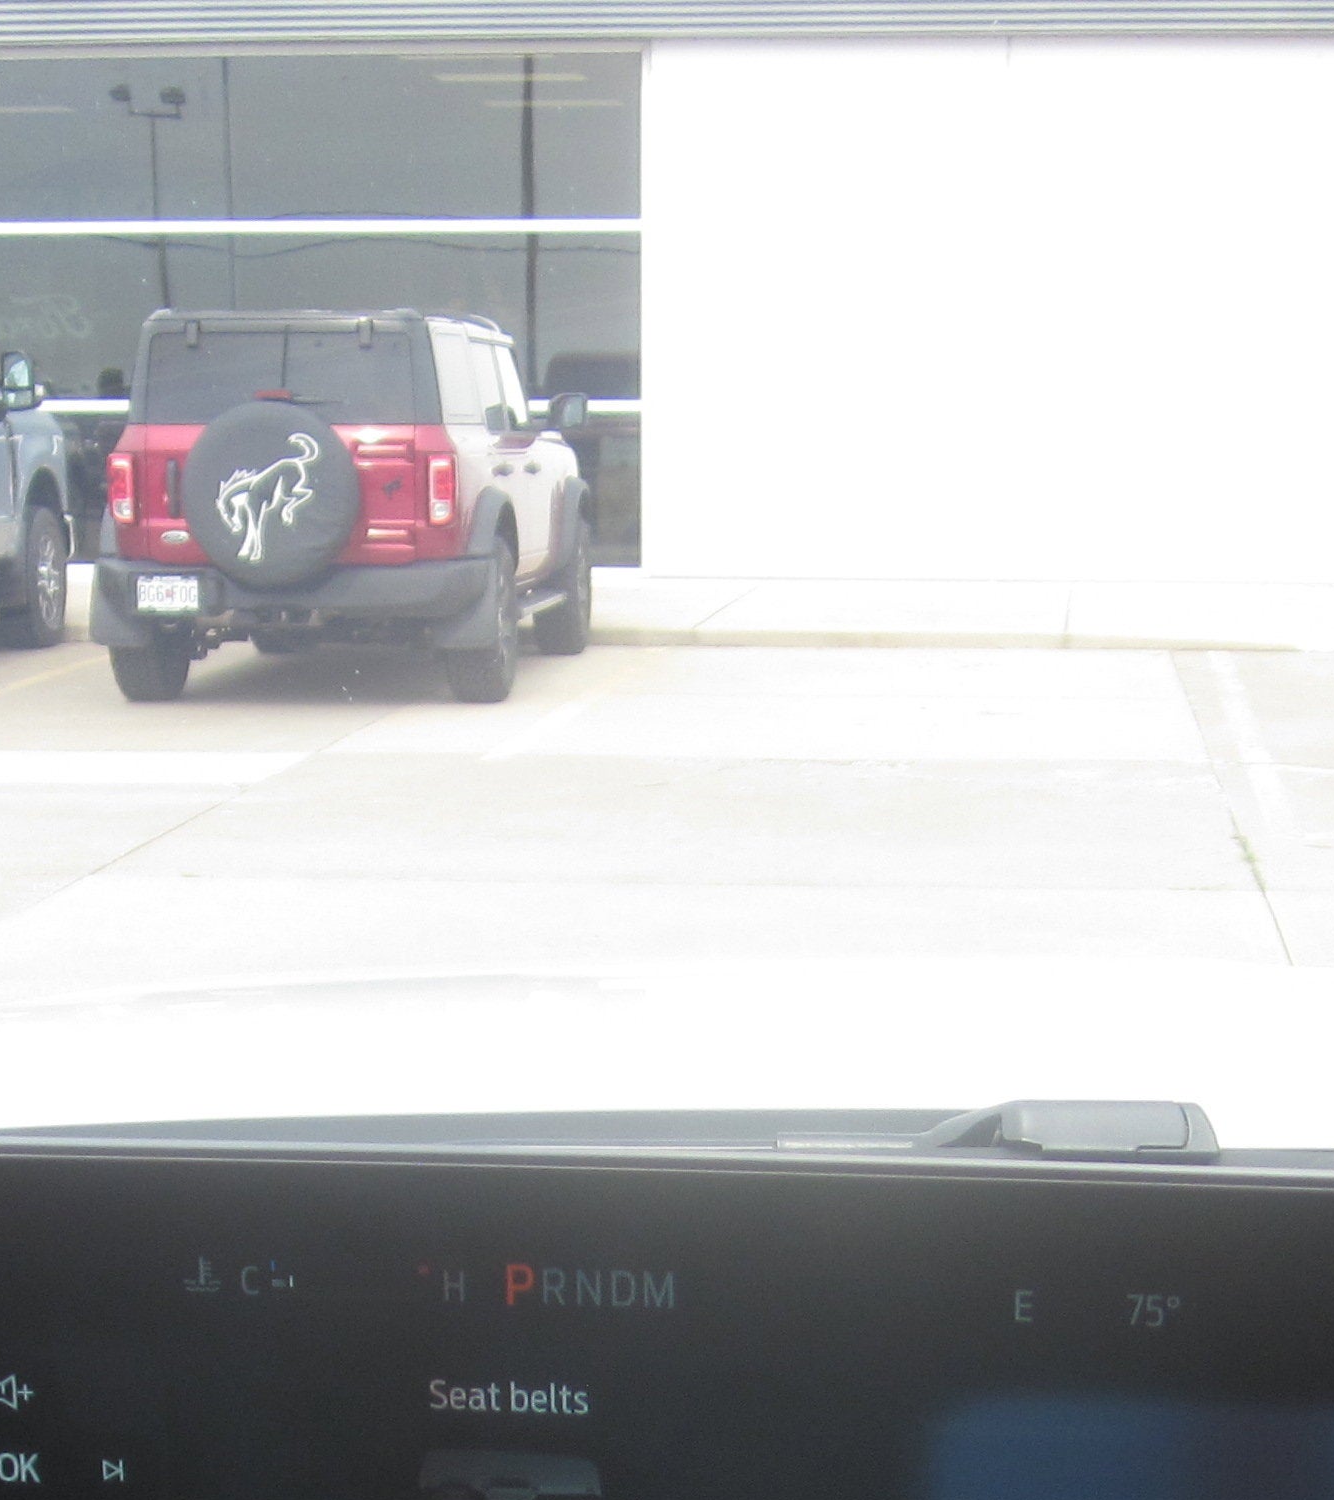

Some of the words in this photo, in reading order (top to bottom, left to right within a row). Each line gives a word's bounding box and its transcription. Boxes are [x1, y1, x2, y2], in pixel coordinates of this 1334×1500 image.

[443, 1271, 465, 1304] H
[1013, 1290, 1034, 1323] E
[1126, 1292, 1181, 1328] 75°
[428, 1379, 501, 1412] Seat
[509, 1380, 589, 1416] belts
